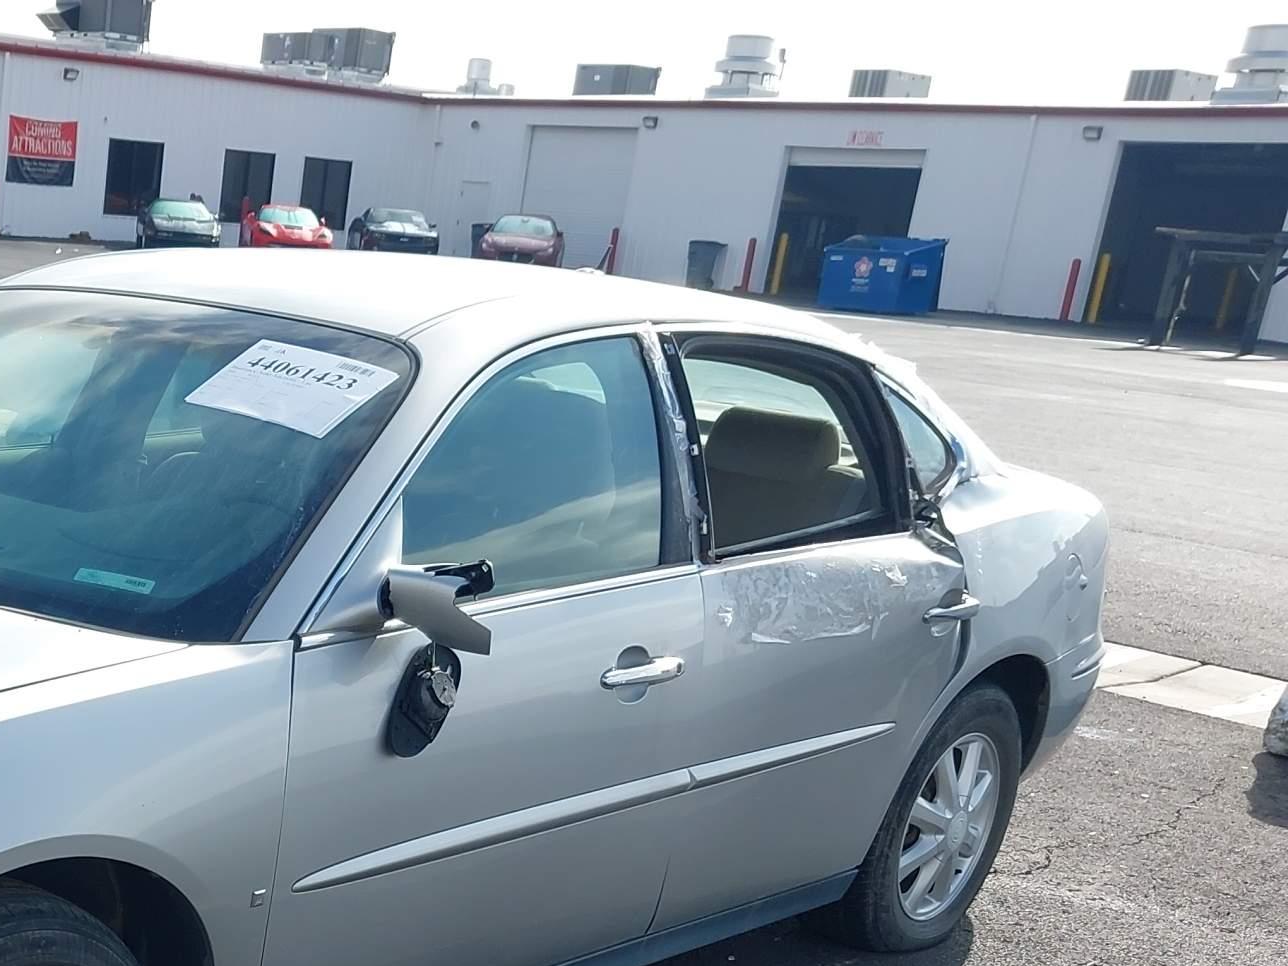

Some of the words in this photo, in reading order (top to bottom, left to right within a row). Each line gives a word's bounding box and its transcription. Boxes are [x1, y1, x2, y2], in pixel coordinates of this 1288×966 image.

[25, 120, 62, 139] COMING
[11, 135, 73, 157] ATTRACTIONS
[247, 356, 359, 390] 44061423
